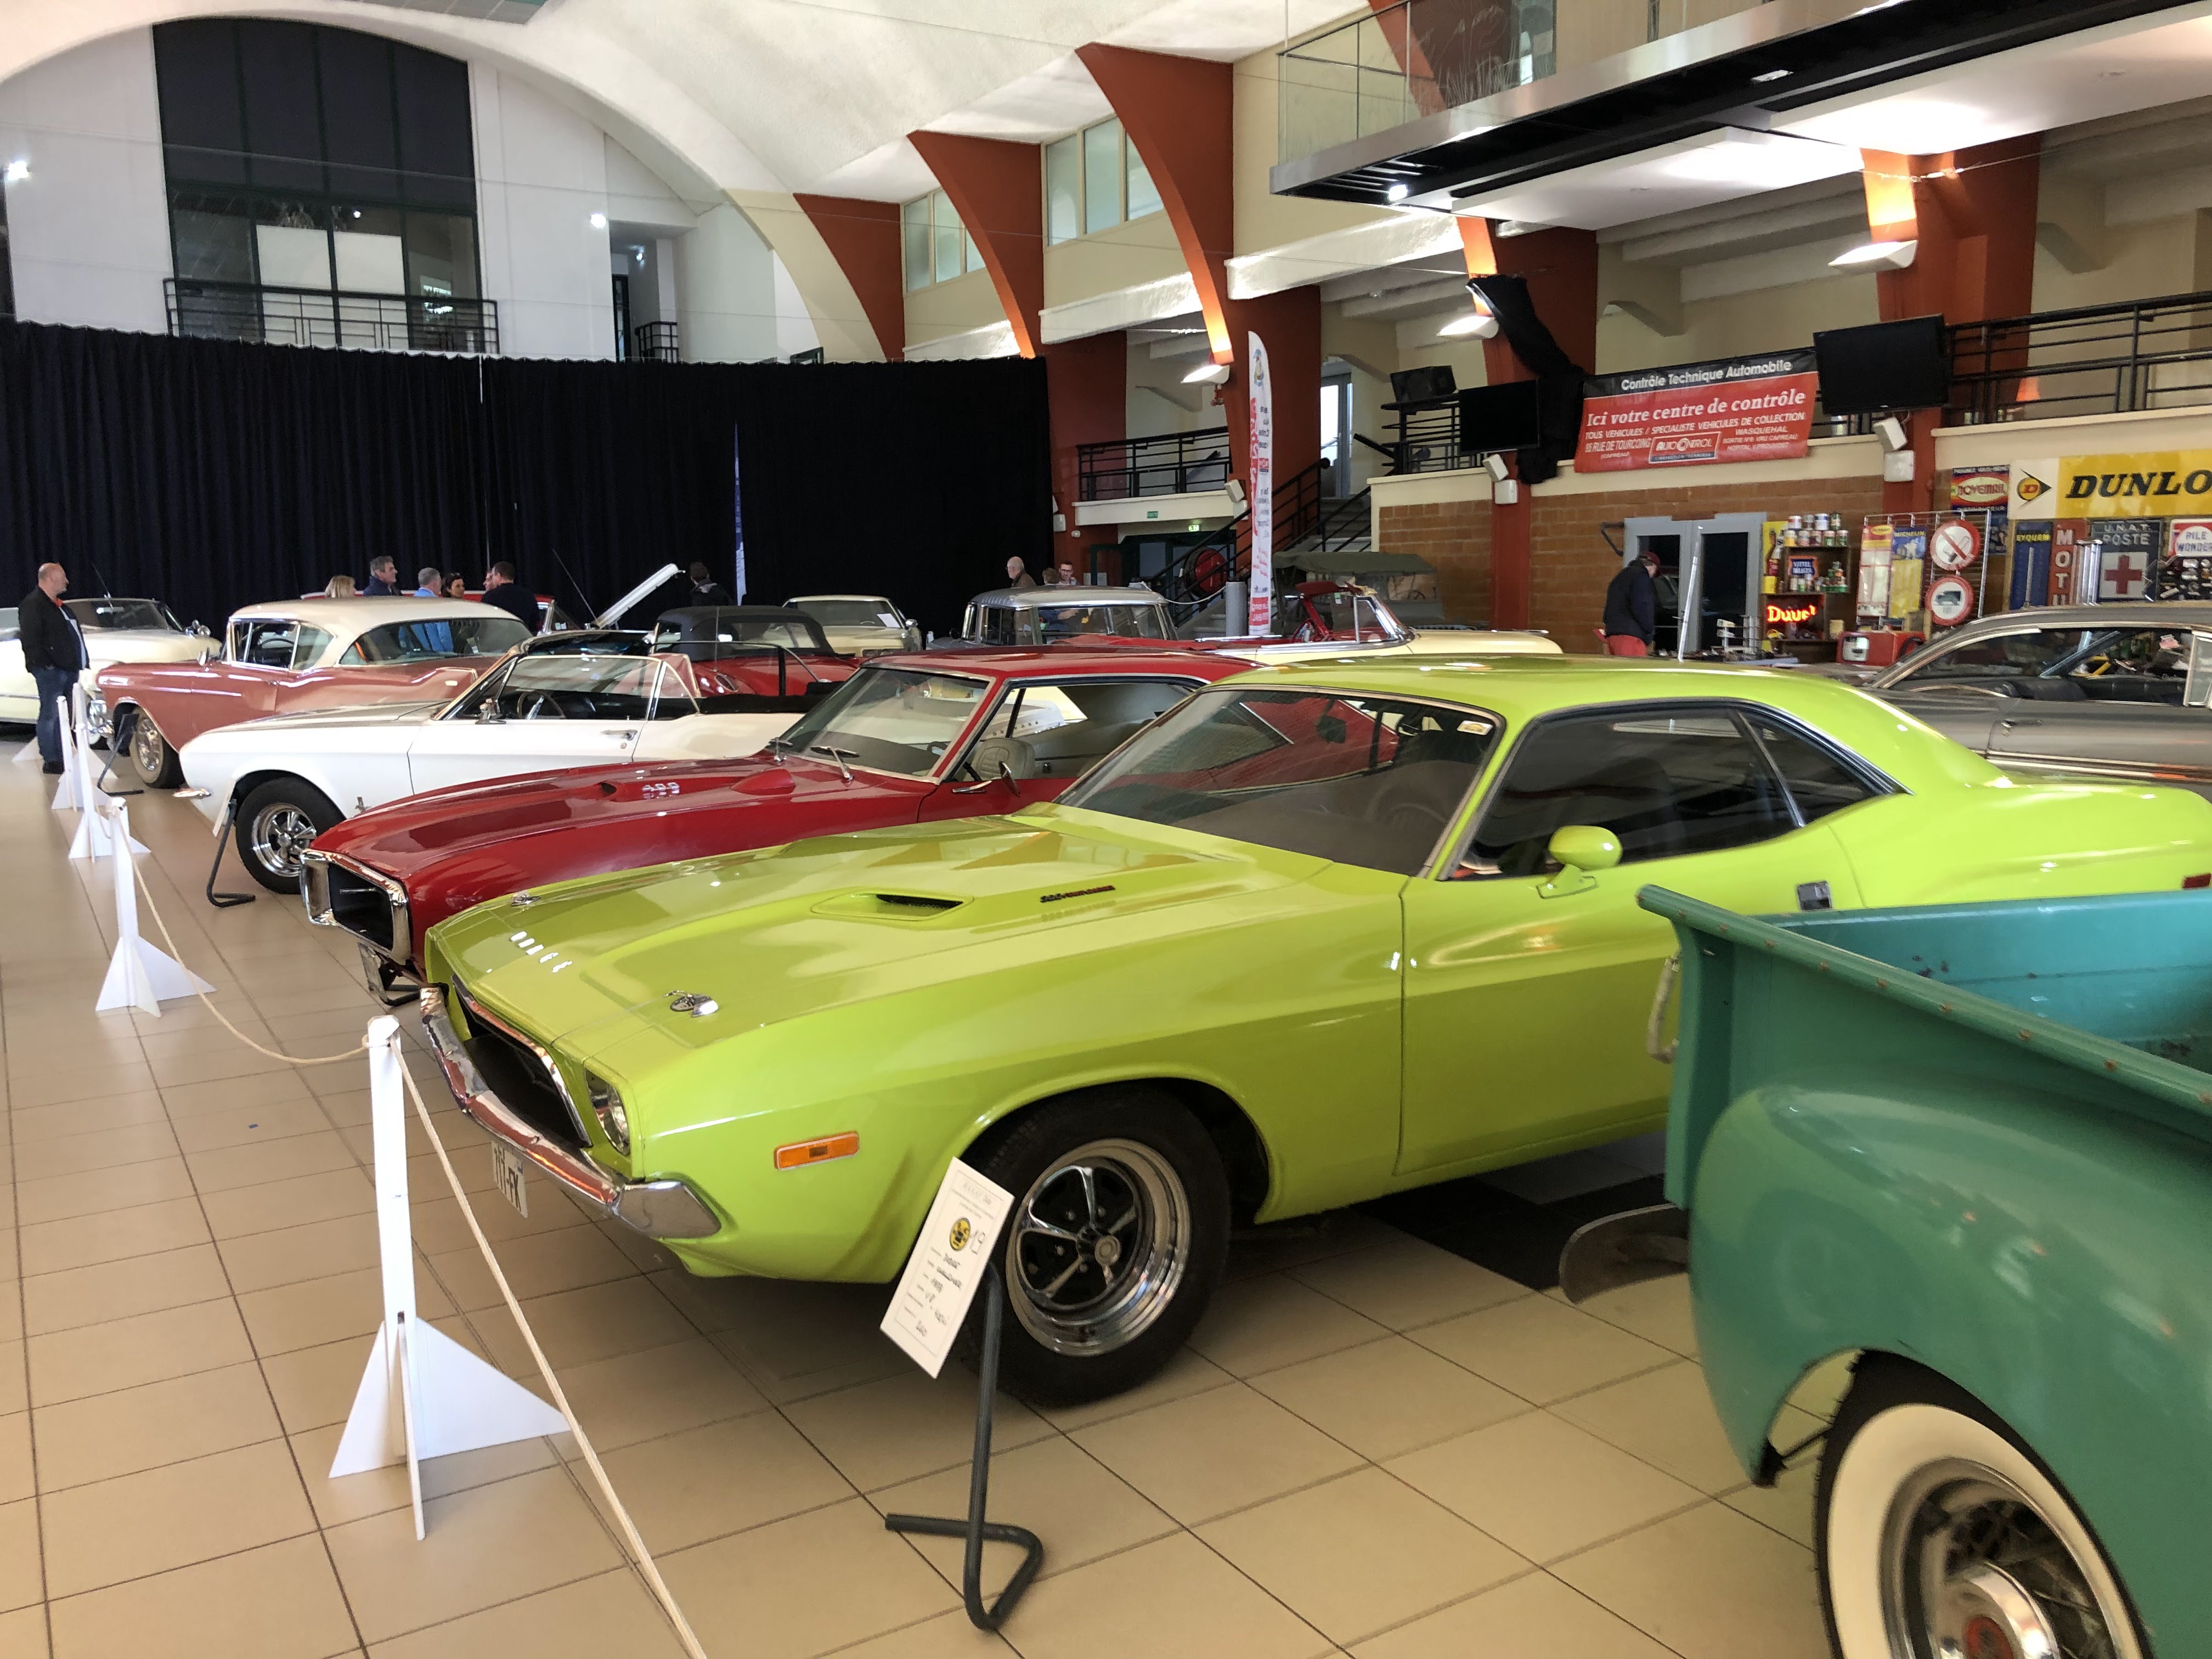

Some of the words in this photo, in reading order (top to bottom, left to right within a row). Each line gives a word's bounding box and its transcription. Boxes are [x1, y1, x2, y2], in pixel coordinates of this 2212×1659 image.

[1621, 376, 1666, 391] Contrôle
[1668, 368, 1723, 386] Technique
[1725, 359, 1792, 379] Automobile
[1587, 411, 1608, 427] Ici
[1611, 410, 1649, 425] votre
[1653, 404, 1705, 420] centre
[1707, 397, 1728, 414] de
[1731, 388, 1806, 411] contrôle
[1585, 431, 1603, 439] TOUS
[1605, 427, 1644, 438] VEHICULES
[1651, 422, 1695, 435] SPECIALISTE
[1698, 418, 1739, 430] VEHICULES
[1741, 417, 1753, 425] DE
[1754, 411, 1807, 425] COLLECTION
[1735, 426, 1788, 436] WASQUEHAL
[1593, 442, 1606, 452] RUE
[1606, 441, 1615, 451] DE
[1615, 437, 1652, 451] TOURCOING
[2022, 484, 2039, 493] D
[2102, 533, 2151, 545] POSTE
[2186, 531, 2207, 540] PILE
